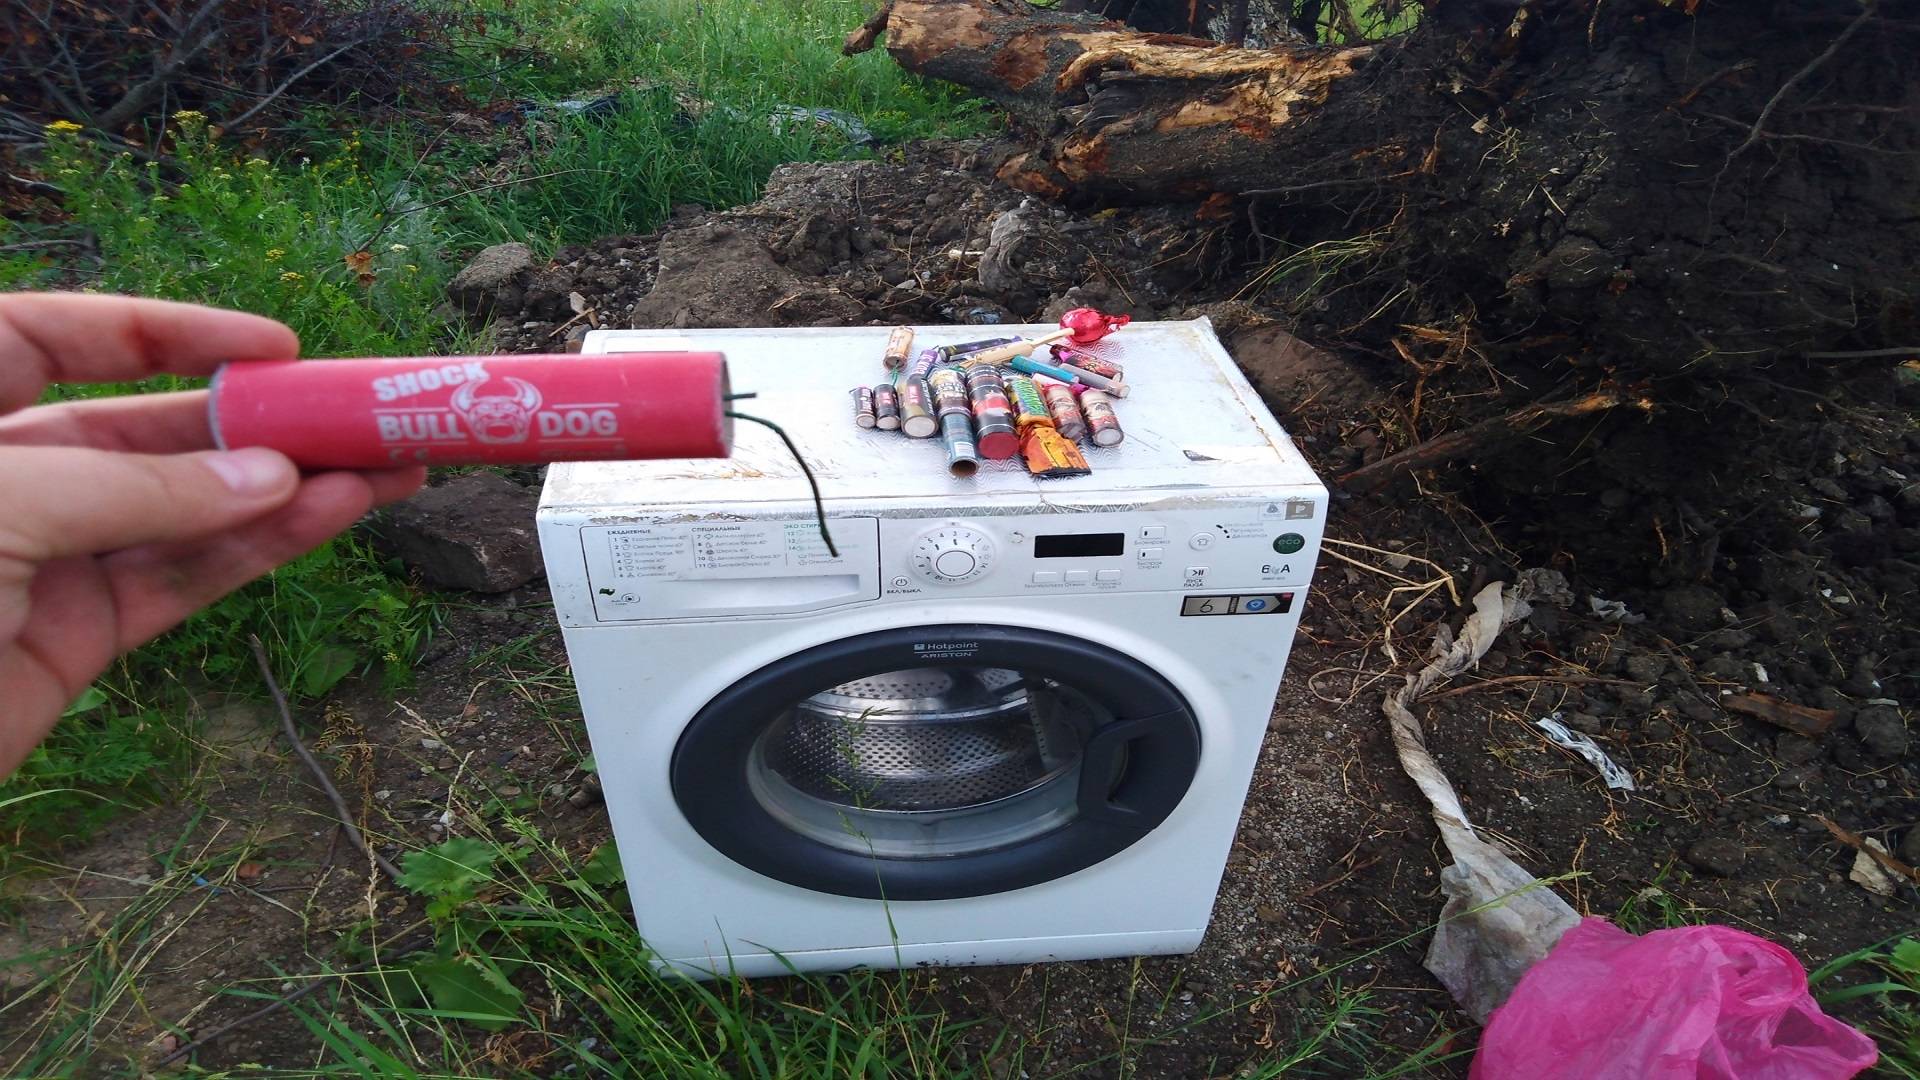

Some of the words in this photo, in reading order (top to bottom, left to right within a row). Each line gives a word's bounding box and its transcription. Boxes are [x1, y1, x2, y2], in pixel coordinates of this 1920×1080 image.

[371, 361, 490, 402] SHOCK
[377, 412, 467, 442] BULL
[538, 410, 619, 437] DOG
[800, 522, 823, 530] СТИРК
[1278, 538, 1301, 546] eco
[1199, 599, 1214, 614] 6
[927, 641, 979, 650] Hotpoint
